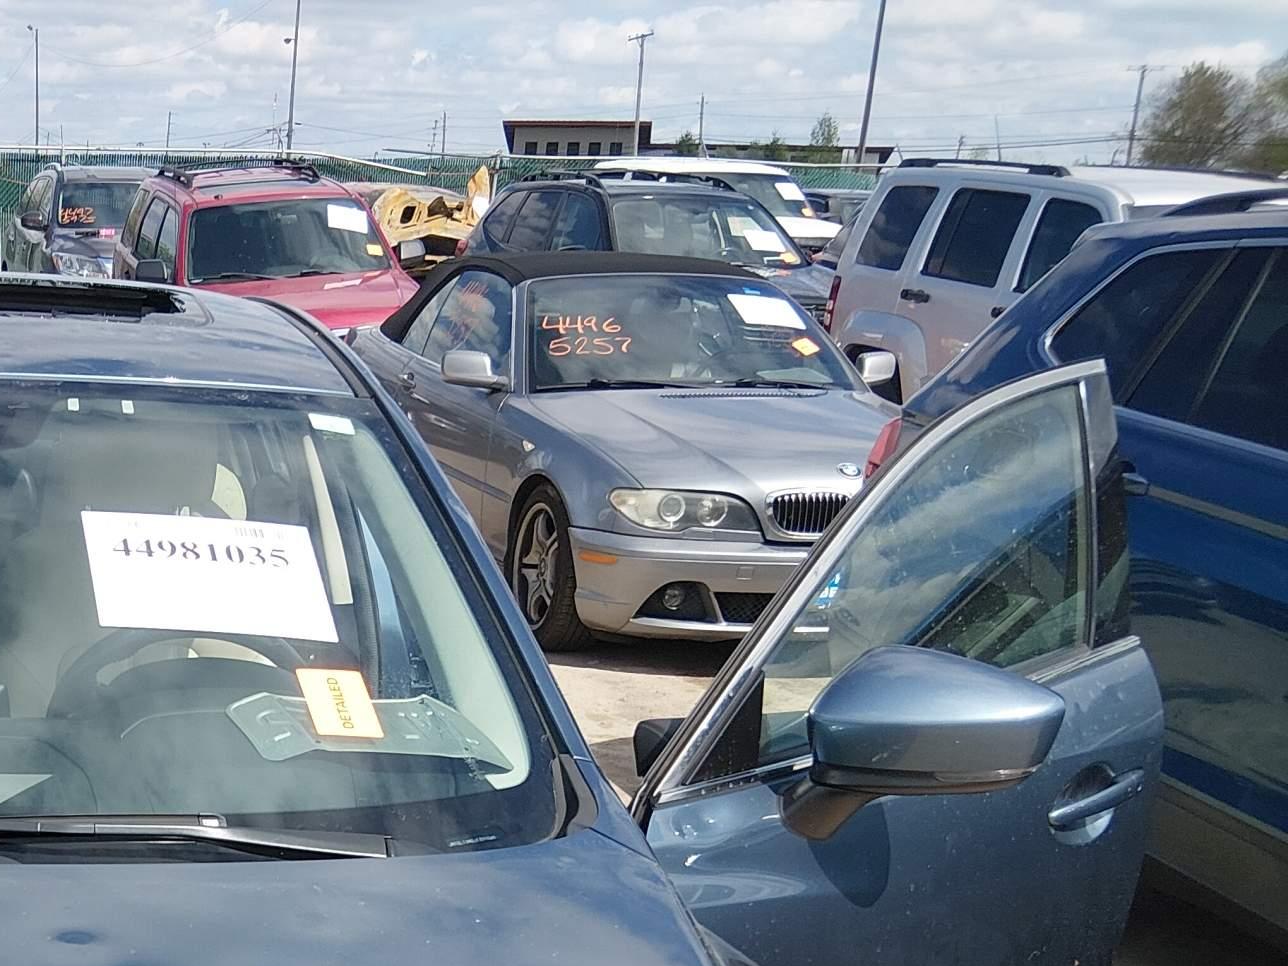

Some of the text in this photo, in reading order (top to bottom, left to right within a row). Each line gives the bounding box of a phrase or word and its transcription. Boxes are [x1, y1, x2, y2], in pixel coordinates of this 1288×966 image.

[541, 315, 623, 335] 4496
[547, 336, 634, 357] 5257
[112, 537, 290, 568] 44981035
[327, 677, 355, 729] DETAILED
